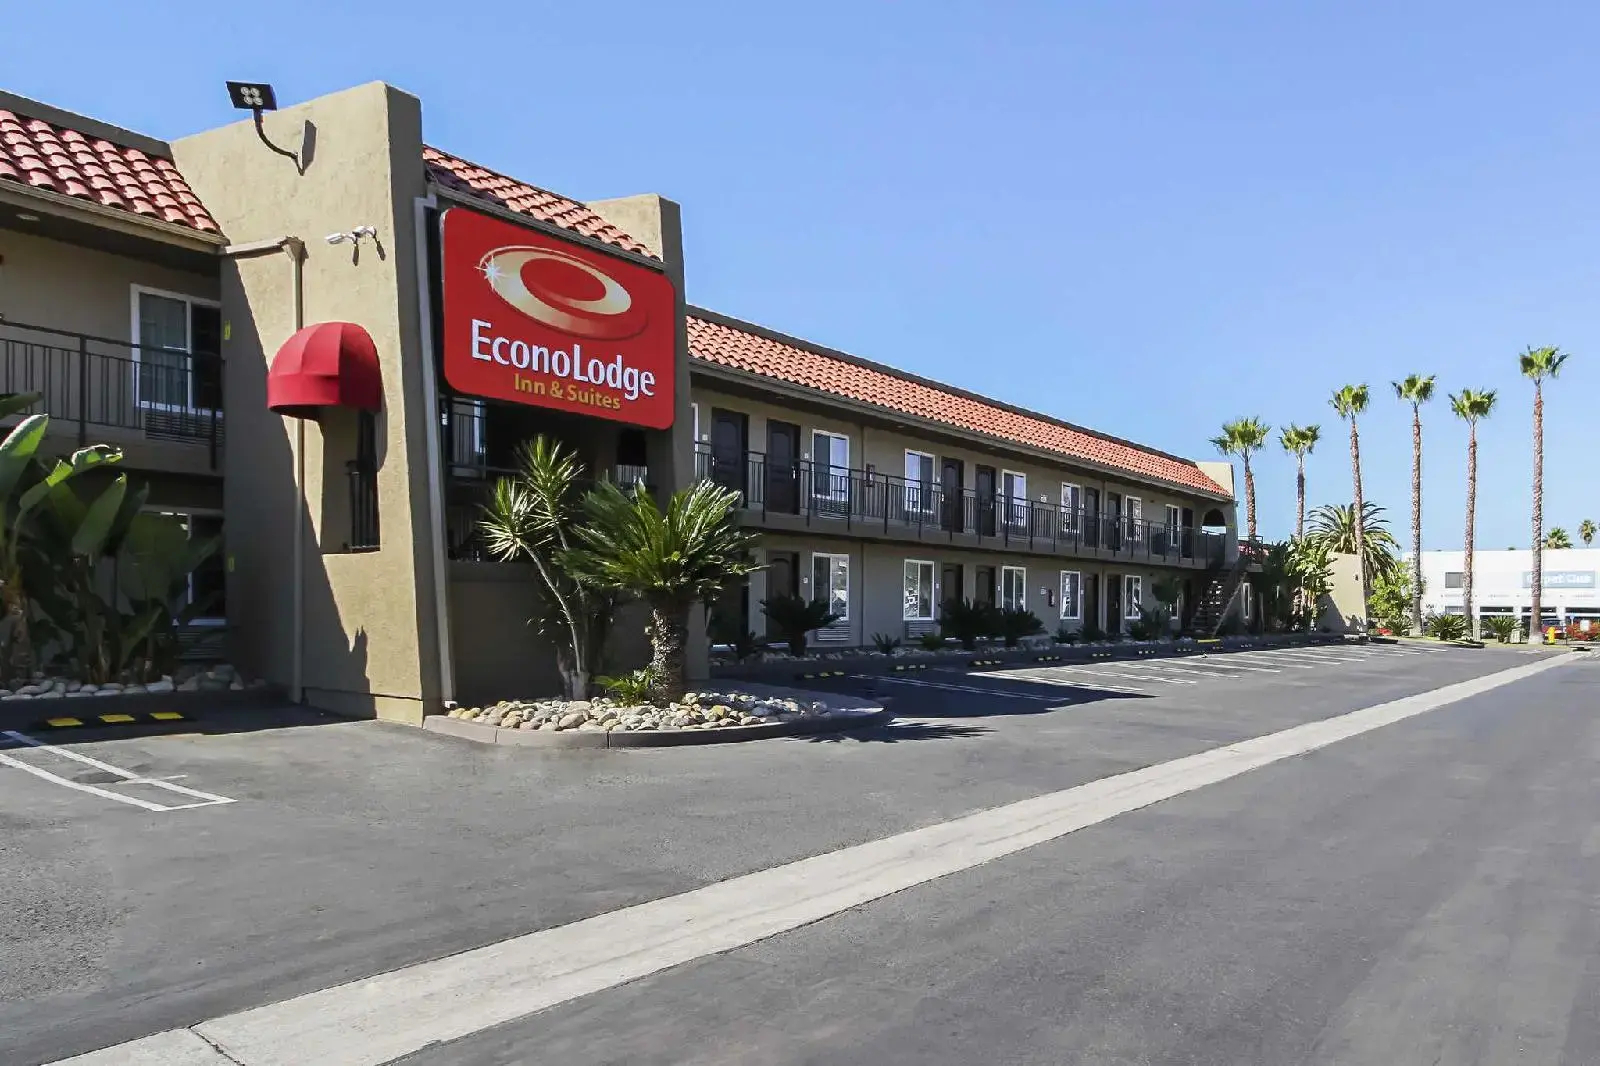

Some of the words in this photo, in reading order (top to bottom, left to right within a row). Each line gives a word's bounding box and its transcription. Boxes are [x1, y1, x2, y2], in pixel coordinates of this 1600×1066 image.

[514, 373, 546, 395] Inn
[549, 380, 563, 398] &
[568, 384, 621, 409] Suites
